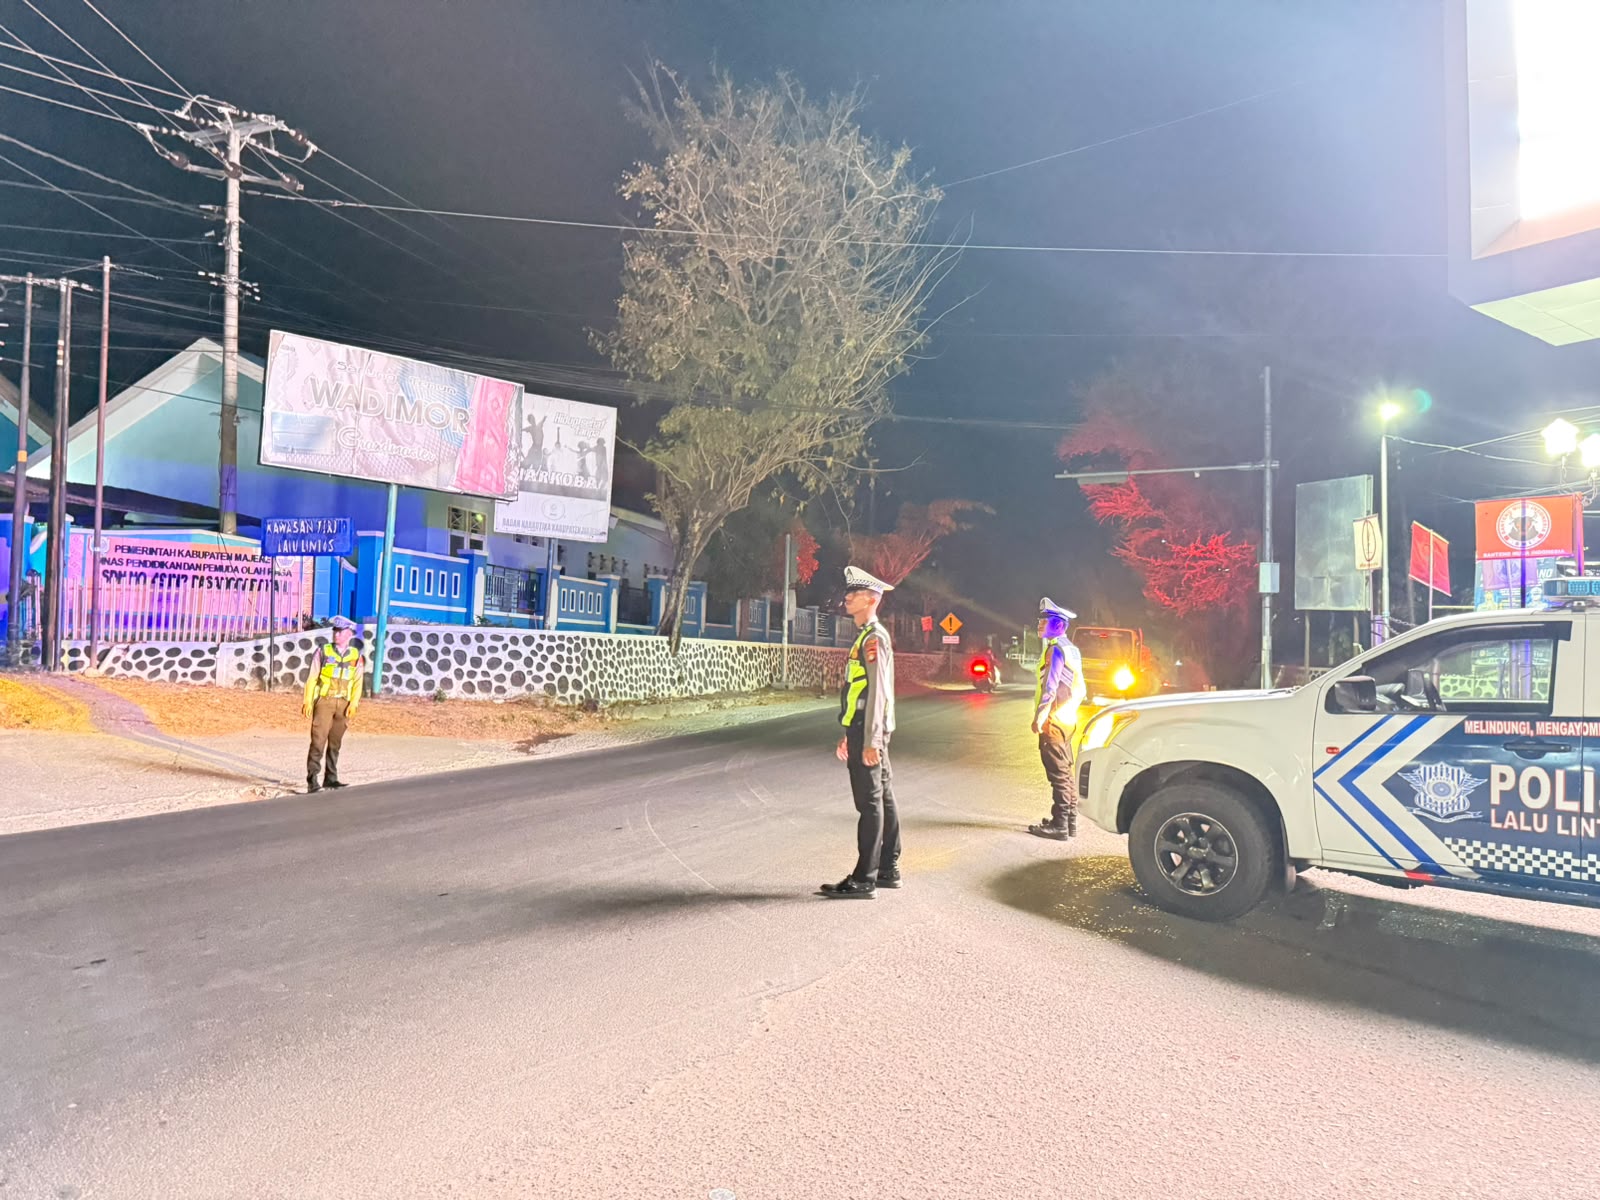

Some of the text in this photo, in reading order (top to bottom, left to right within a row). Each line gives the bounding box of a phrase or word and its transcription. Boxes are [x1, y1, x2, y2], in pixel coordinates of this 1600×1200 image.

[309, 376, 471, 434] WADIMOR
[266, 520, 314, 534] KAWASAN
[114, 544, 176, 557] PEMERINTAH
[177, 548, 233, 561] KABUPATEN
[100, 557, 124, 566] INAS
[126, 558, 182, 570] PENDIDIKAN
[183, 562, 202, 571] DAN
[203, 563, 240, 574] PEMUDA
[241, 566, 266, 575] OLAH
[1464, 720, 1534, 737] MELINDUNGI,
[1490, 763, 1600, 814] POLI
[1490, 808, 1548, 833] LALU
